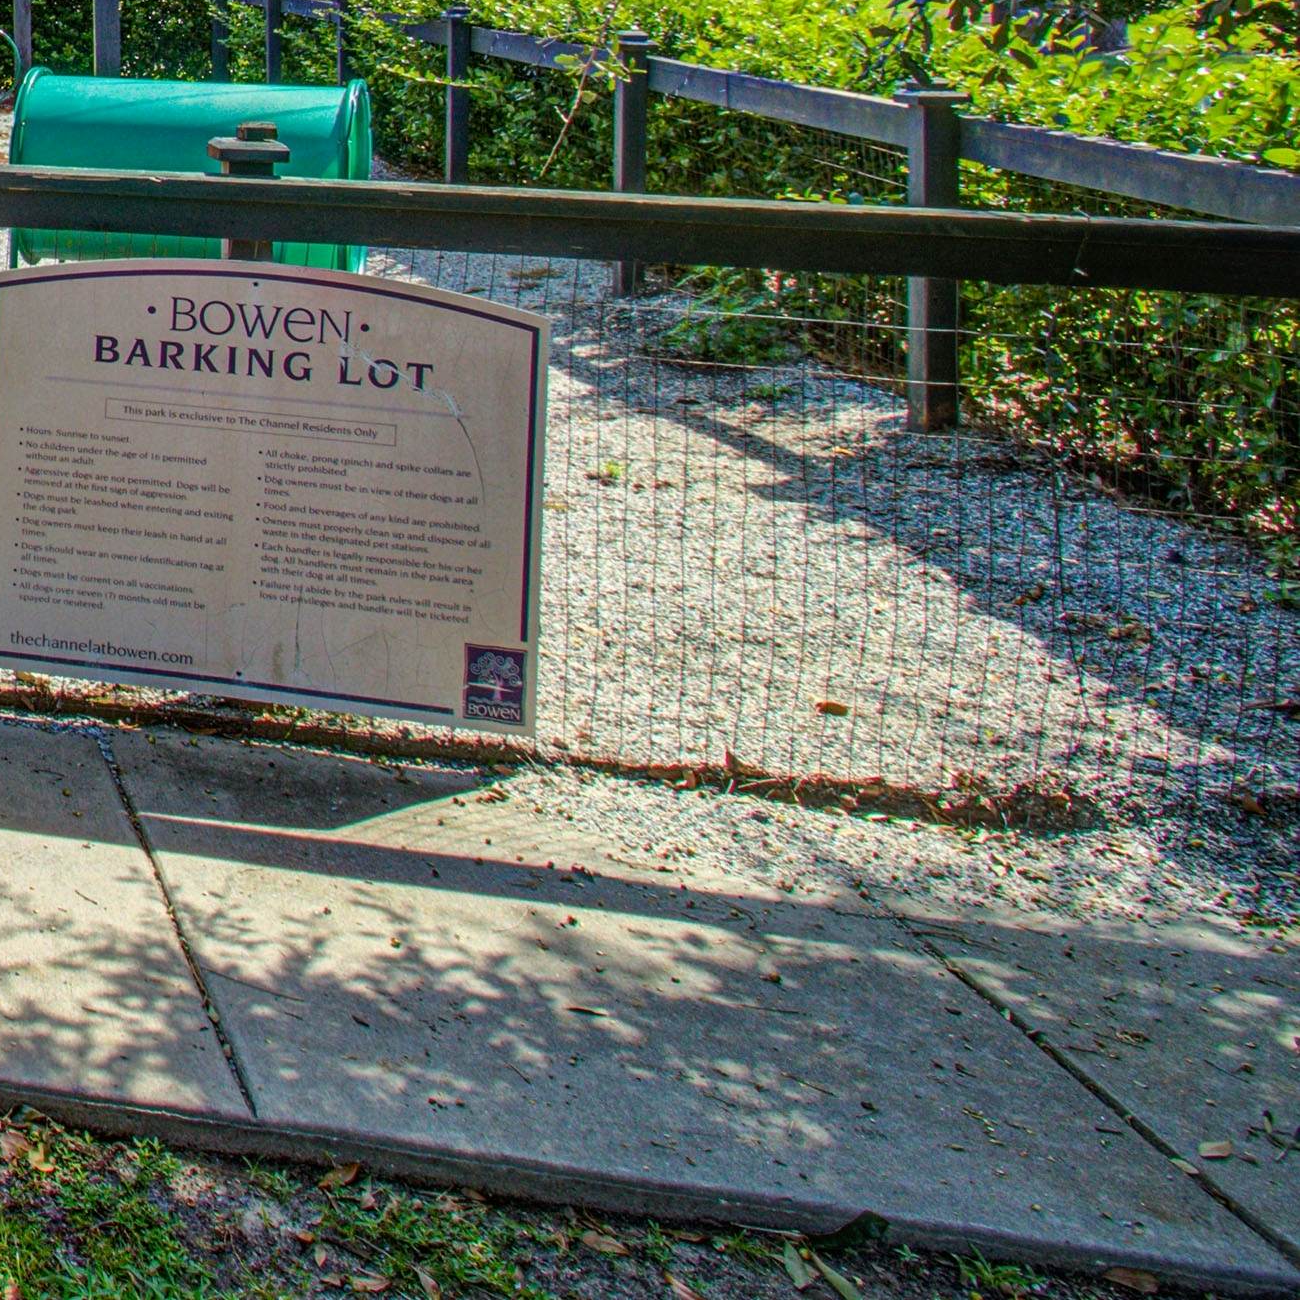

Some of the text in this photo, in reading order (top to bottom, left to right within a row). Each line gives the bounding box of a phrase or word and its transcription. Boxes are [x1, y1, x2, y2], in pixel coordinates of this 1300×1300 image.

[94, 334, 434, 390] BARKING LOT
[122, 405, 142, 414] This
[144, 408, 166, 417] park
[178, 412, 223, 422] exclusive
[238, 416, 256, 425] The
[258, 418, 299, 429] Channel
[302, 422, 351, 434] Residents
[353, 426, 378, 439] Only
[25, 440, 37, 448] No
[39, 442, 75, 452] children
[76, 446, 102, 455] under
[104, 448, 119, 456] the
[120, 452, 136, 460] age
[162, 456, 206, 465] permitted
[264, 449, 277, 457] All
[311, 456, 338, 466] prong
[340, 457, 373, 469] (pinch)
[395, 463, 420, 472] spike
[422, 466, 453, 475] collars
[24, 465, 69, 477] Aggressive
[71, 470, 92, 481] dogs
[174, 481, 198, 492] Dogs
[218, 485, 230, 493] be
[284, 480, 317, 488] owners
[344, 484, 356, 492] be
[405, 490, 427, 499] their
[429, 492, 452, 504] dogs
[22, 491, 44, 502] Dogs
[69, 496, 81, 504] be
[83, 497, 118, 508] leashed
[120, 502, 143, 511] when
[145, 506, 182, 517] entering
[203, 512, 233, 522] exiting
[262, 502, 286, 511] Food
[308, 506, 355, 519] beverages
[369, 515, 386, 524] any
[388, 514, 409, 524] kind
[41, 520, 71, 529] owners
[96, 524, 119, 536] keep
[121, 527, 141, 536] their
[143, 530, 167, 539] leash
[179, 533, 202, 543] hand
[262, 517, 296, 527] Owners
[322, 525, 362, 536] properly
[364, 528, 389, 537] clean
[391, 532, 404, 541] up
[427, 534, 464, 546] dispose
[300, 533, 316, 541] the
[318, 534, 370, 547] designated
[372, 542, 388, 550] pet
[20, 542, 42, 553] Dogs
[44, 545, 74, 554] should
[260, 542, 283, 552] Each
[285, 545, 320, 556] handler
[365, 556, 420, 567] responsible
[422, 560, 435, 569] for
[437, 562, 451, 570] his
[466, 565, 482, 574] her
[19, 567, 41, 578] Dogs
[66, 572, 78, 581] be
[80, 576, 110, 584] current
[281, 568, 302, 577] their
[304, 570, 323, 581] dog
[282, 556, 295, 565] All
[297, 558, 337, 569] handlers
[364, 567, 397, 576] remain
[410, 571, 426, 579] the
[428, 574, 450, 582] park
[259, 580, 290, 591] Failure
[305, 586, 331, 596] abide
[333, 589, 345, 599] by
[347, 591, 363, 599] the
[365, 594, 386, 602] park
[388, 596, 412, 605] rules
[433, 602, 460, 610] result
[10, 630, 194, 666] thechannelatbowen.com
